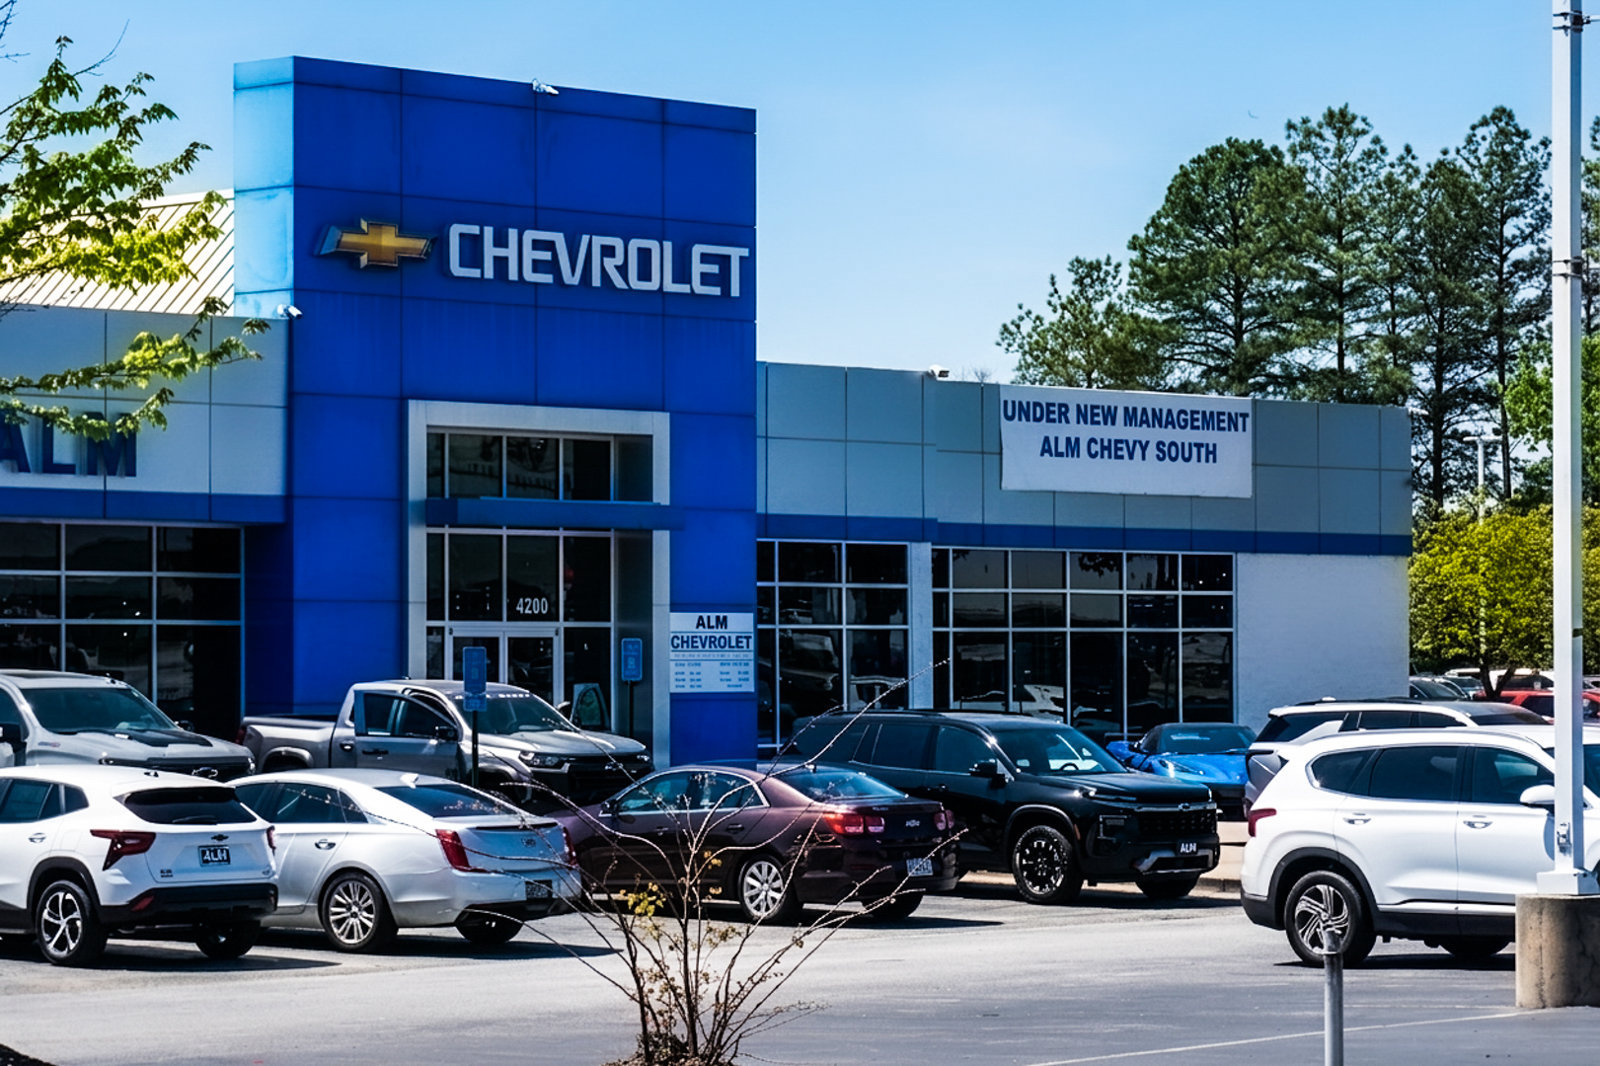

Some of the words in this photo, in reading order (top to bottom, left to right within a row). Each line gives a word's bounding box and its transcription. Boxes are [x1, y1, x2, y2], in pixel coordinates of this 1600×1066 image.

[449, 223, 749, 297] CHEVROLET
[1003, 399, 1070, 424] UNDER
[1076, 403, 1118, 426] NEW
[1123, 406, 1249, 432] MANAGEMENT
[0, 408, 136, 477] ALM
[1040, 435, 1080, 459] ALM
[1087, 437, 1149, 461] CHEVY
[1155, 440, 1217, 464] SOUTH
[515, 597, 548, 614] 4200
[695, 615, 728, 629] ALM
[670, 635, 752, 649] CHEVROLET
